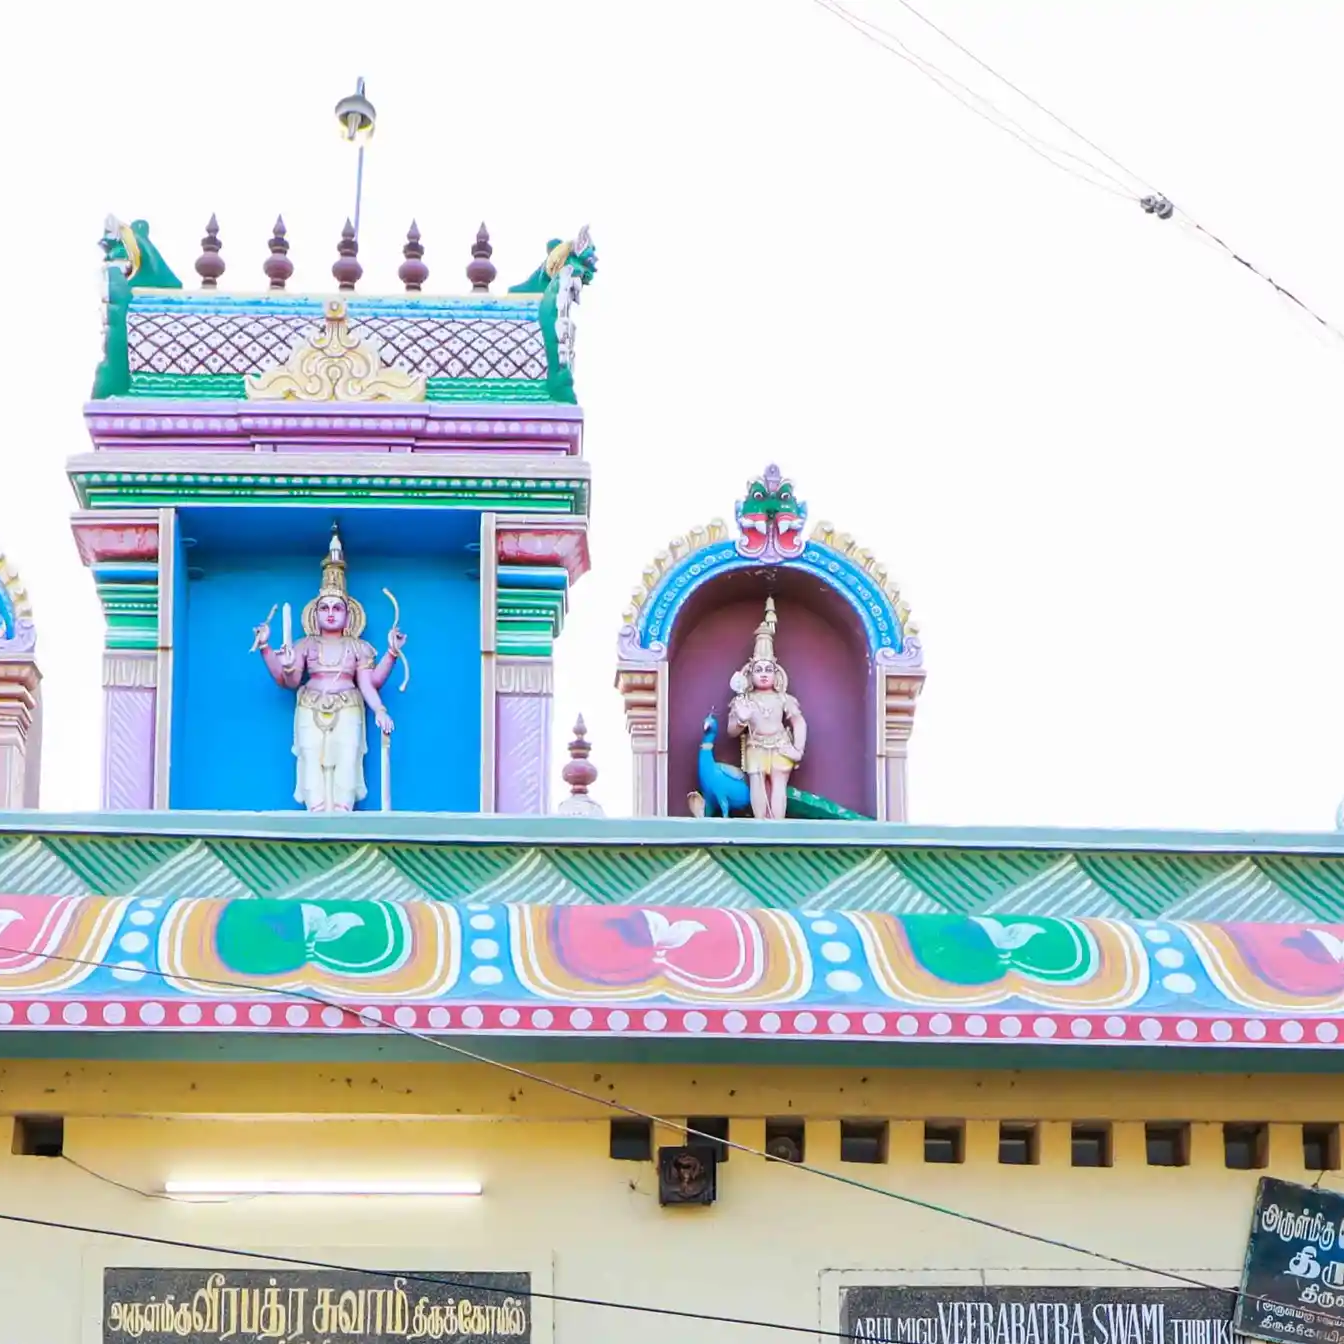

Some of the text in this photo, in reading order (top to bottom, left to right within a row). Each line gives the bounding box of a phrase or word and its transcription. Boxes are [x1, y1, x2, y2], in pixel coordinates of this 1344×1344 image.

[1262, 1204, 1335, 1251] அருள்மிகு
[107, 1294, 192, 1338] அருள்மிகு
[312, 1276, 409, 1336] சுவாமி
[406, 1296, 526, 1340] திருக்கோயில்
